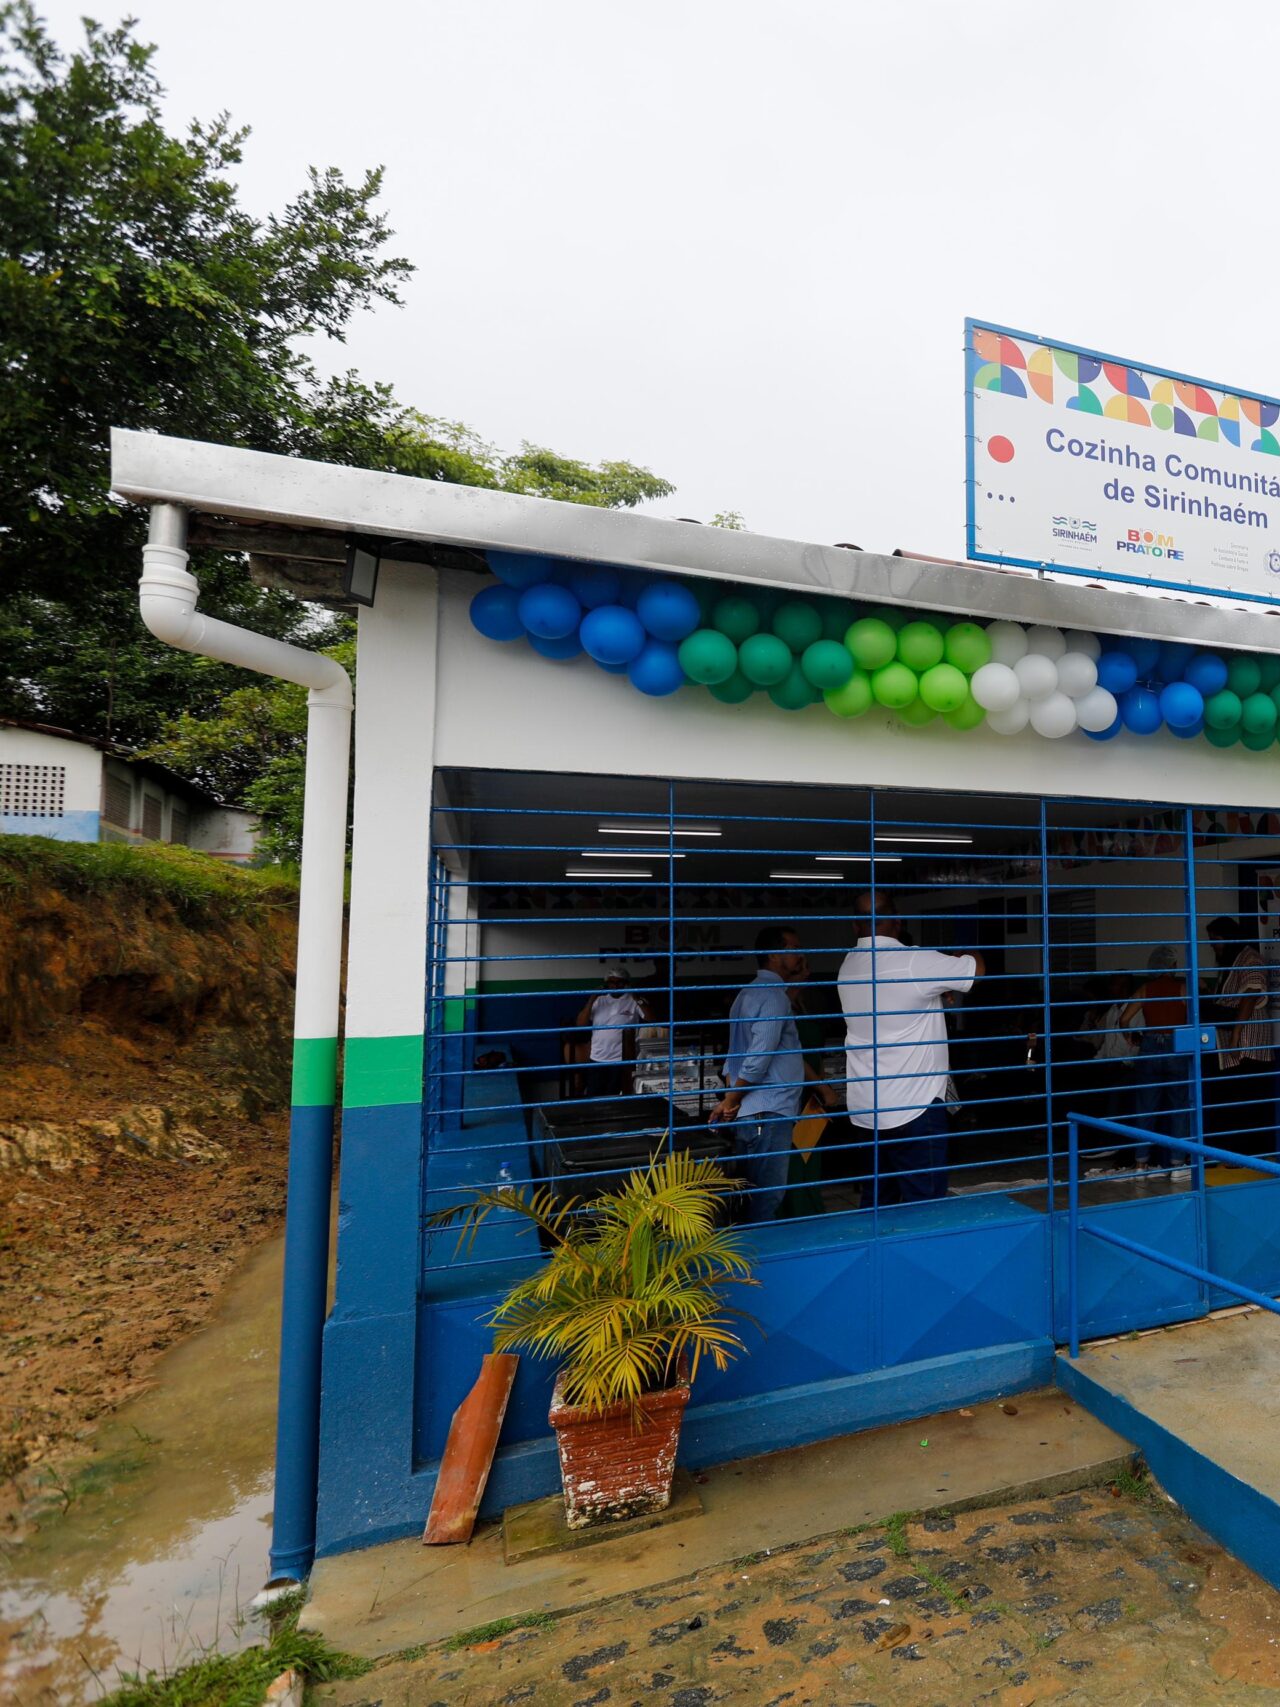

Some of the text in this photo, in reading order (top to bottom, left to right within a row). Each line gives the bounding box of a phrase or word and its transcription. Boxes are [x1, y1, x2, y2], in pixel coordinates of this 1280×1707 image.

[1045, 428, 1157, 472] Cozinha
[1103, 478, 1269, 529] de Sirinhaém
[1052, 528, 1098, 544] SIRINHAÉM
[1127, 528, 1175, 548] BOM
[1116, 541, 1163, 557] PRATO
